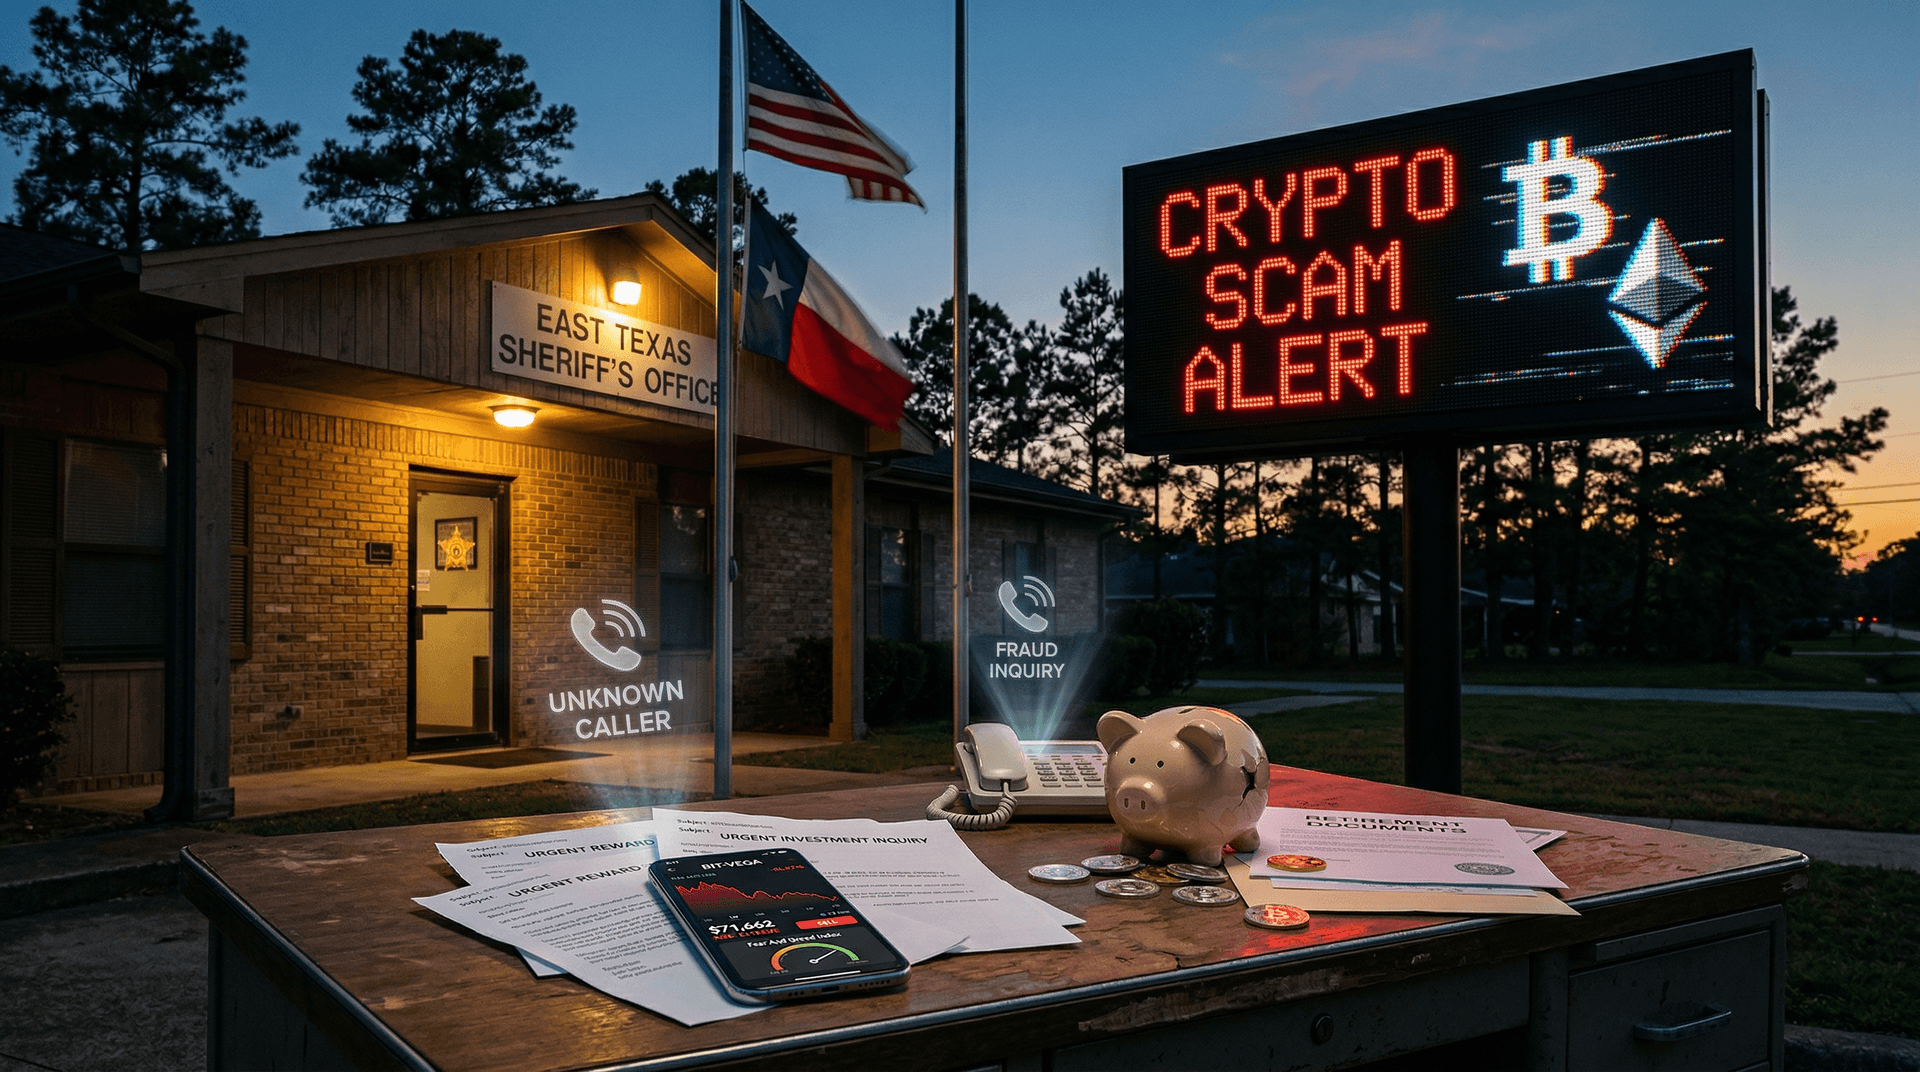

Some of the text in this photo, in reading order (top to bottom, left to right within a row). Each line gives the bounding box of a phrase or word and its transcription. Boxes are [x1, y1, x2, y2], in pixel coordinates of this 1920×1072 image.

[1160, 148, 1453, 258] CRYPTO
[1205, 240, 1400, 329] SCAM
[537, 303, 692, 366] EAST TEXAS
[499, 333, 718, 406] SHERIFF’S OFFICE
[1185, 322, 1428, 412] ALERT
[996, 641, 1058, 657] FRAUD
[989, 662, 1065, 679] INQUIRY
[548, 679, 684, 713] UNKNOWN
[575, 710, 672, 739] CALLER
[1305, 815, 1464, 827] RETIREMENT
[1306, 821, 1467, 834] DOCUMENTS
[524, 839, 655, 858] URGENT REWARD
[720, 832, 929, 845] URGENT INVESTMENT INQUIRY
[508, 878, 575, 898] URGENT
[576, 865, 642, 883] REWARD
[708, 919, 776, 935] $71,662
